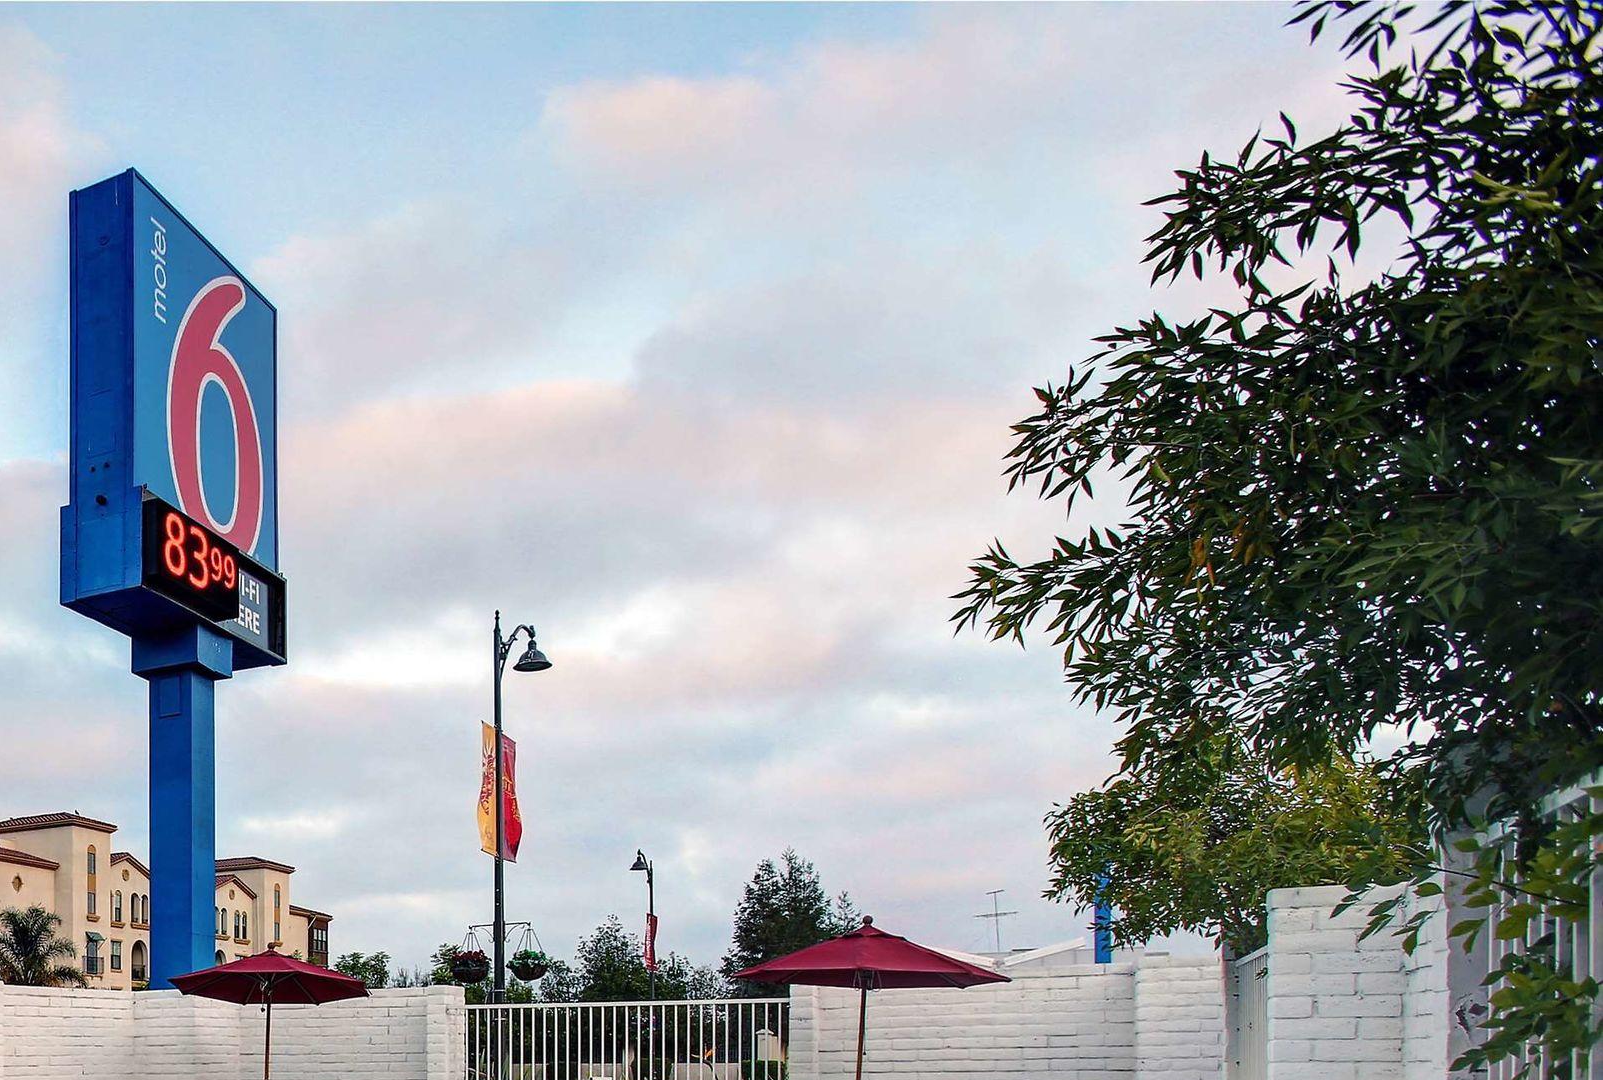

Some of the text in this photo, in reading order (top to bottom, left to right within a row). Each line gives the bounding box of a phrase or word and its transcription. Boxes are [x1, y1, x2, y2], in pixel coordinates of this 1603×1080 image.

[150, 216, 167, 324] motel
[166, 275, 264, 556] 6
[234, 603, 260, 635] ERE
[238, 572, 260, 605] I-FI
